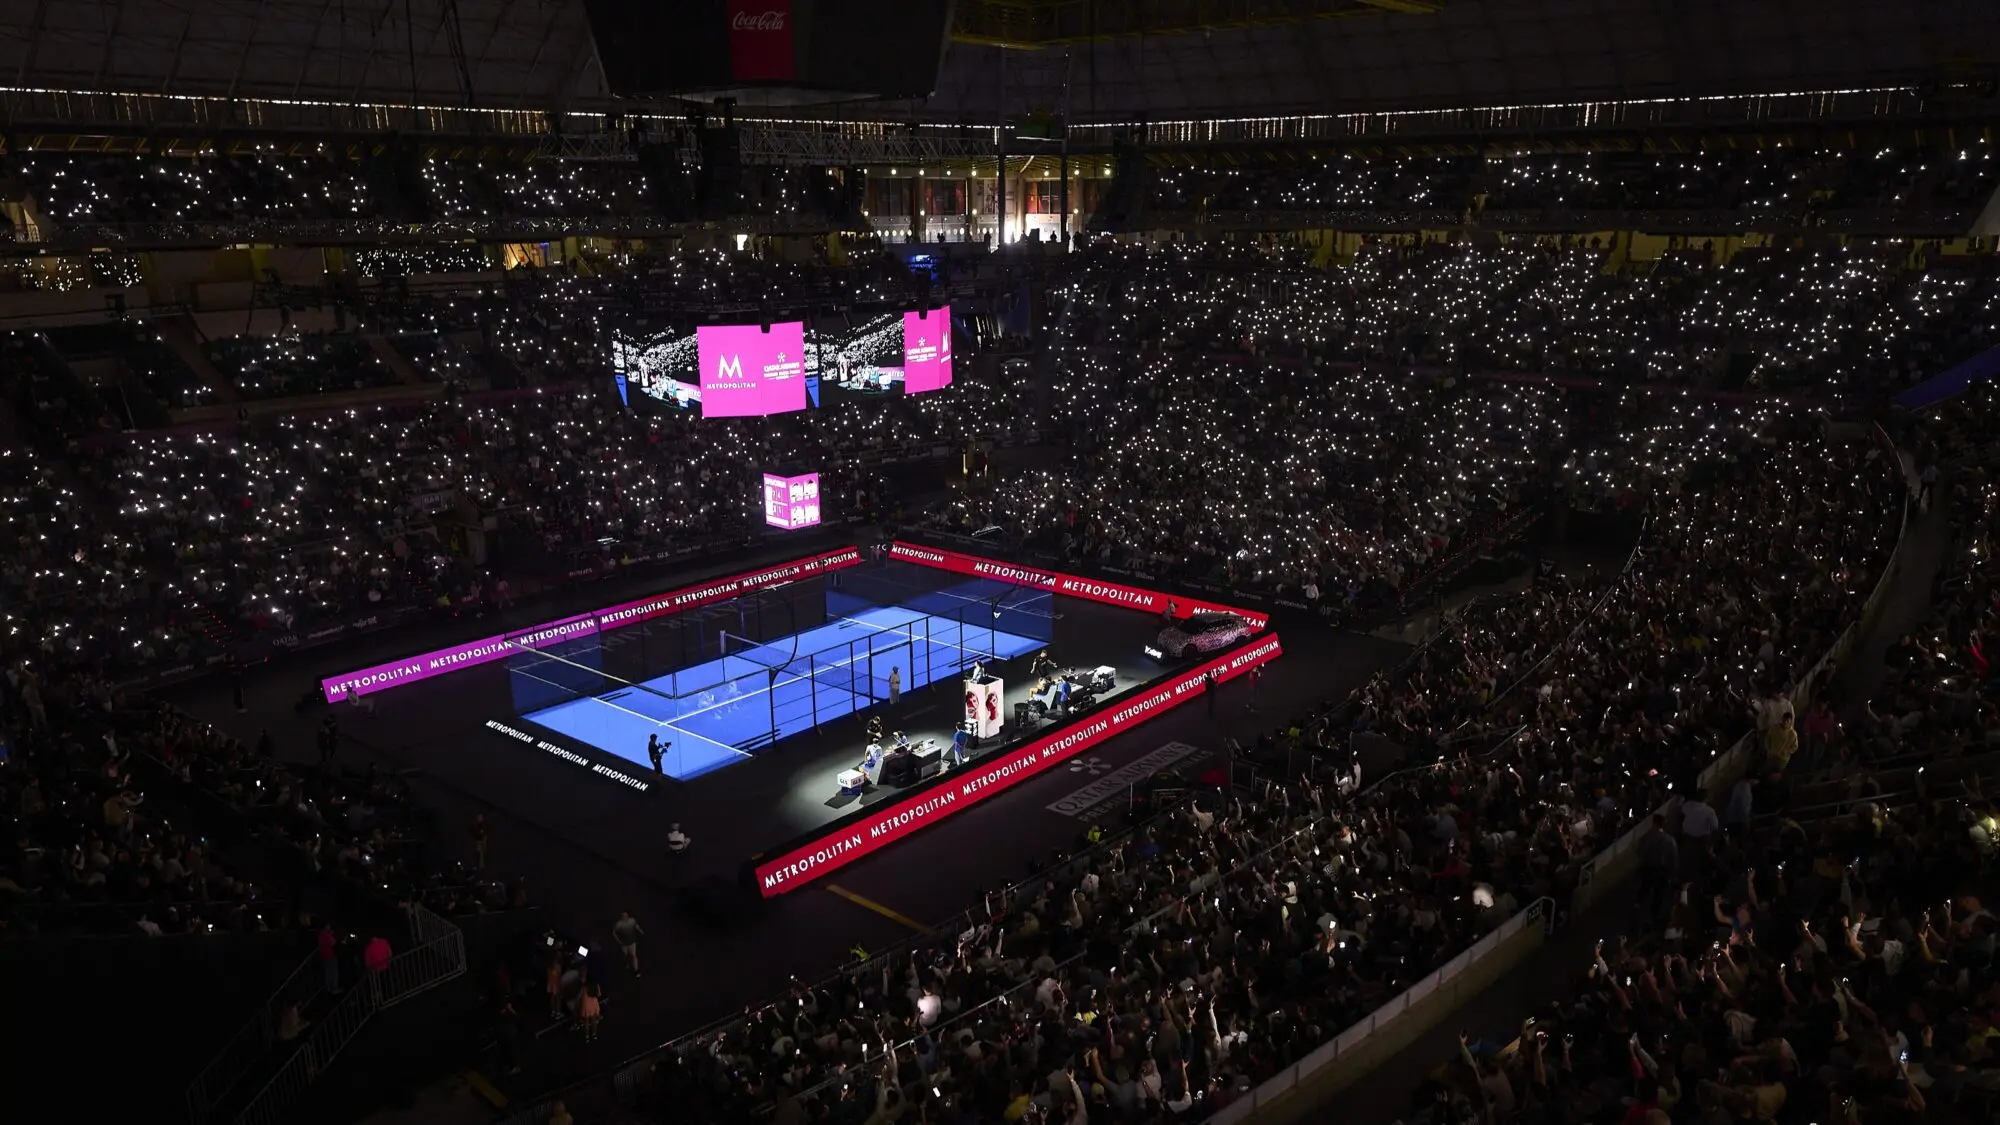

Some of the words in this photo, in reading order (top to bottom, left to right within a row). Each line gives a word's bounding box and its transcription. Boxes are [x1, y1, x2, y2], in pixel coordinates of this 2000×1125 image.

[706, 382, 757, 390] METROPOLITAN
[718, 354, 744, 380] M
[892, 545, 944, 562] METROPOLITAN
[1062, 579, 1154, 606] METROPOLITAN
[330, 663, 422, 695] METROPOLITAN
[430, 640, 513, 670] METROPOLITAN
[519, 618, 595, 646] METROPOLITAN
[601, 599, 670, 625] METROPOLITAN
[675, 582, 738, 605] METROPOLITAN
[804, 551, 858, 572] METOPOLITAN
[485, 719, 534, 744] METROPOLITAN
[537, 740, 590, 767] METROPOLITAN
[592, 763, 649, 792] METROPOLITAN
[765, 833, 862, 889] METROPOLITAN
[871, 791, 956, 838] METROPOLITAN
[962, 753, 1037, 796] METROPOLITAN
[1042, 719, 1108, 758] METROPOLITAN
[1112, 689, 1172, 725] METROPOLITAN
[1175, 663, 1228, 696] METROPOITAN
[1231, 640, 1279, 669] METROPOLITAN
[1055, 778, 1122, 812] QATAR
[1120, 745, 1189, 783] AIRWAYS
